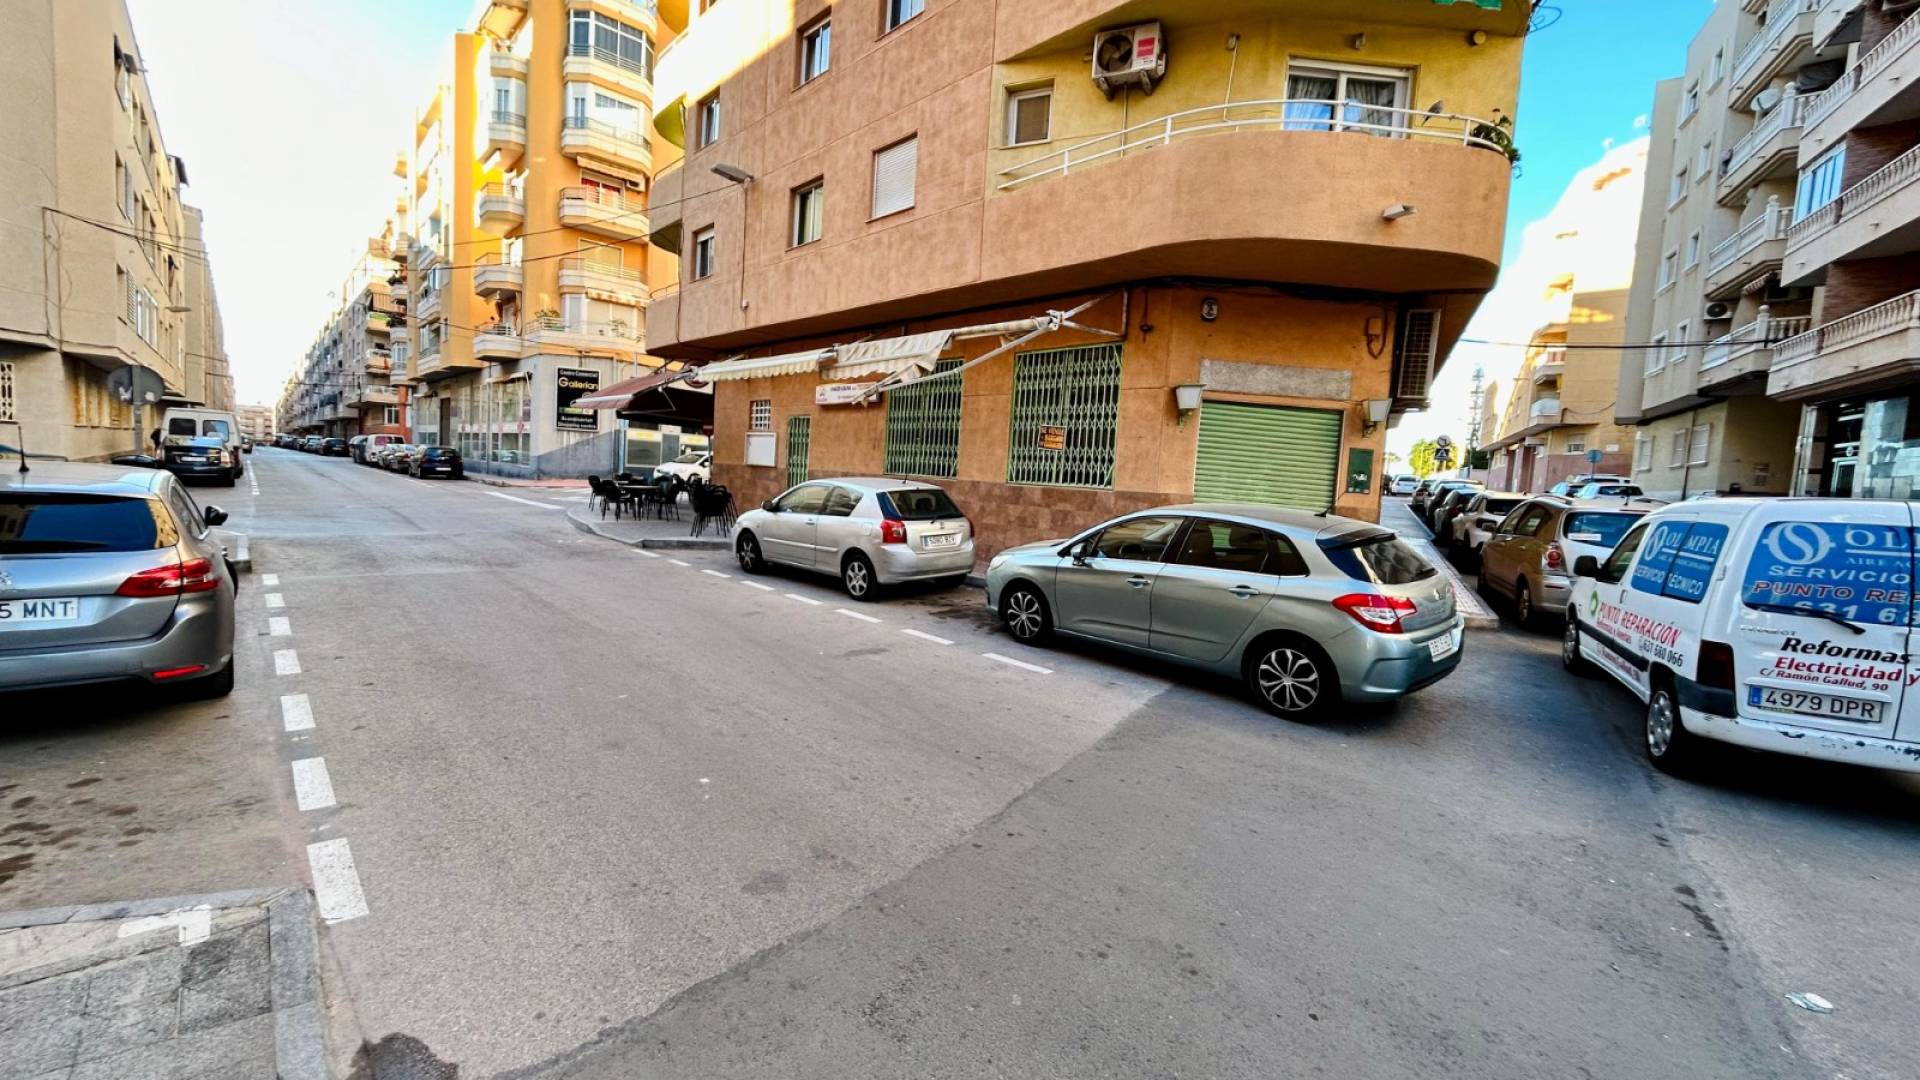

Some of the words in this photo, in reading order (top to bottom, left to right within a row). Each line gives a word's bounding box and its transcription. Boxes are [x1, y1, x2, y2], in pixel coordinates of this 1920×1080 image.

[1768, 565, 1910, 584] SERVICIO
[1752, 580, 1854, 600] PUNTO
[23, 601, 72, 619] MNT
[1621, 611, 1681, 648] REPARACIÓN
[1781, 637, 1911, 665] Reformas
[1775, 656, 1903, 682] Electricidad
[1776, 669, 1819, 683] Ramón
[1871, 682, 1889, 691] 90
[1765, 690, 1823, 711] 4979
[1830, 698, 1875, 719] DPR
